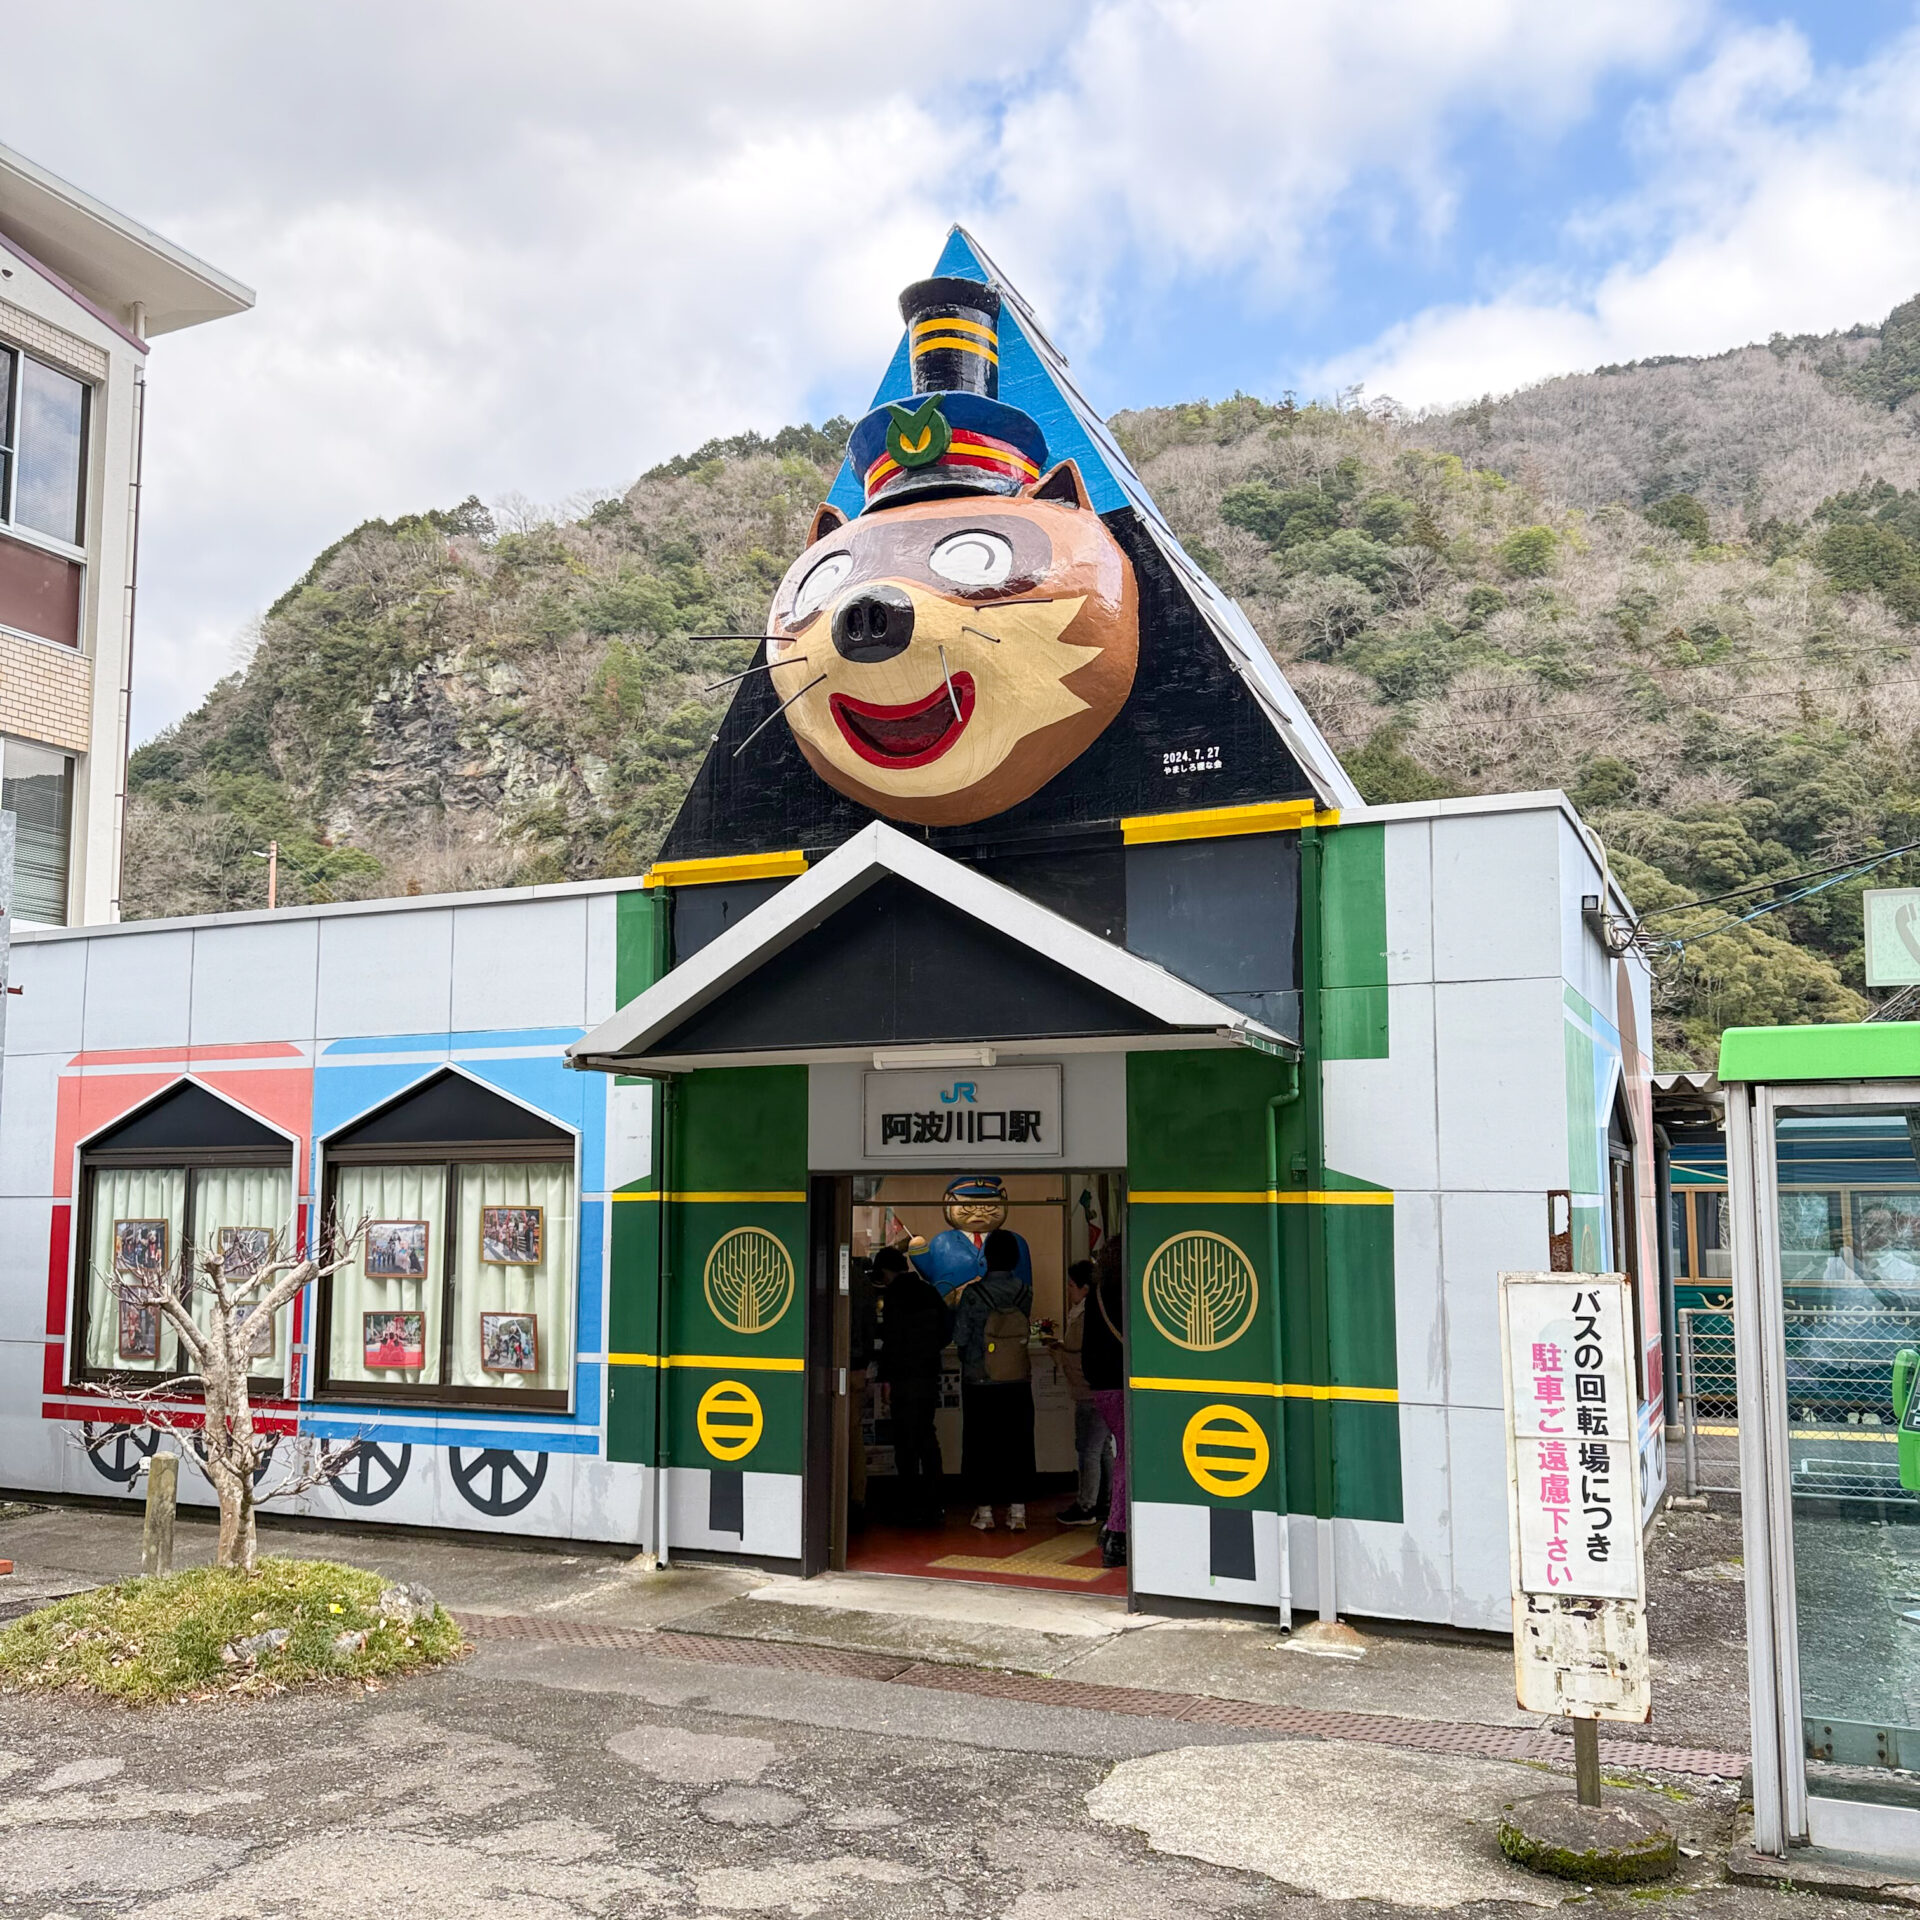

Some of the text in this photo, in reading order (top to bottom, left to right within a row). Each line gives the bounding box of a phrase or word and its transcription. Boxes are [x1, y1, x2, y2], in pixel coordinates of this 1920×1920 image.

[1163, 746, 1220, 764] 2024.7.27
[940, 1081, 978, 1104] JR
[881, 1110, 1041, 1145] 阿波川口駅
[1571, 1289, 1613, 1562] バスの回転場につき
[1531, 1342, 1573, 1587] 駐車ご遠慮下さい
